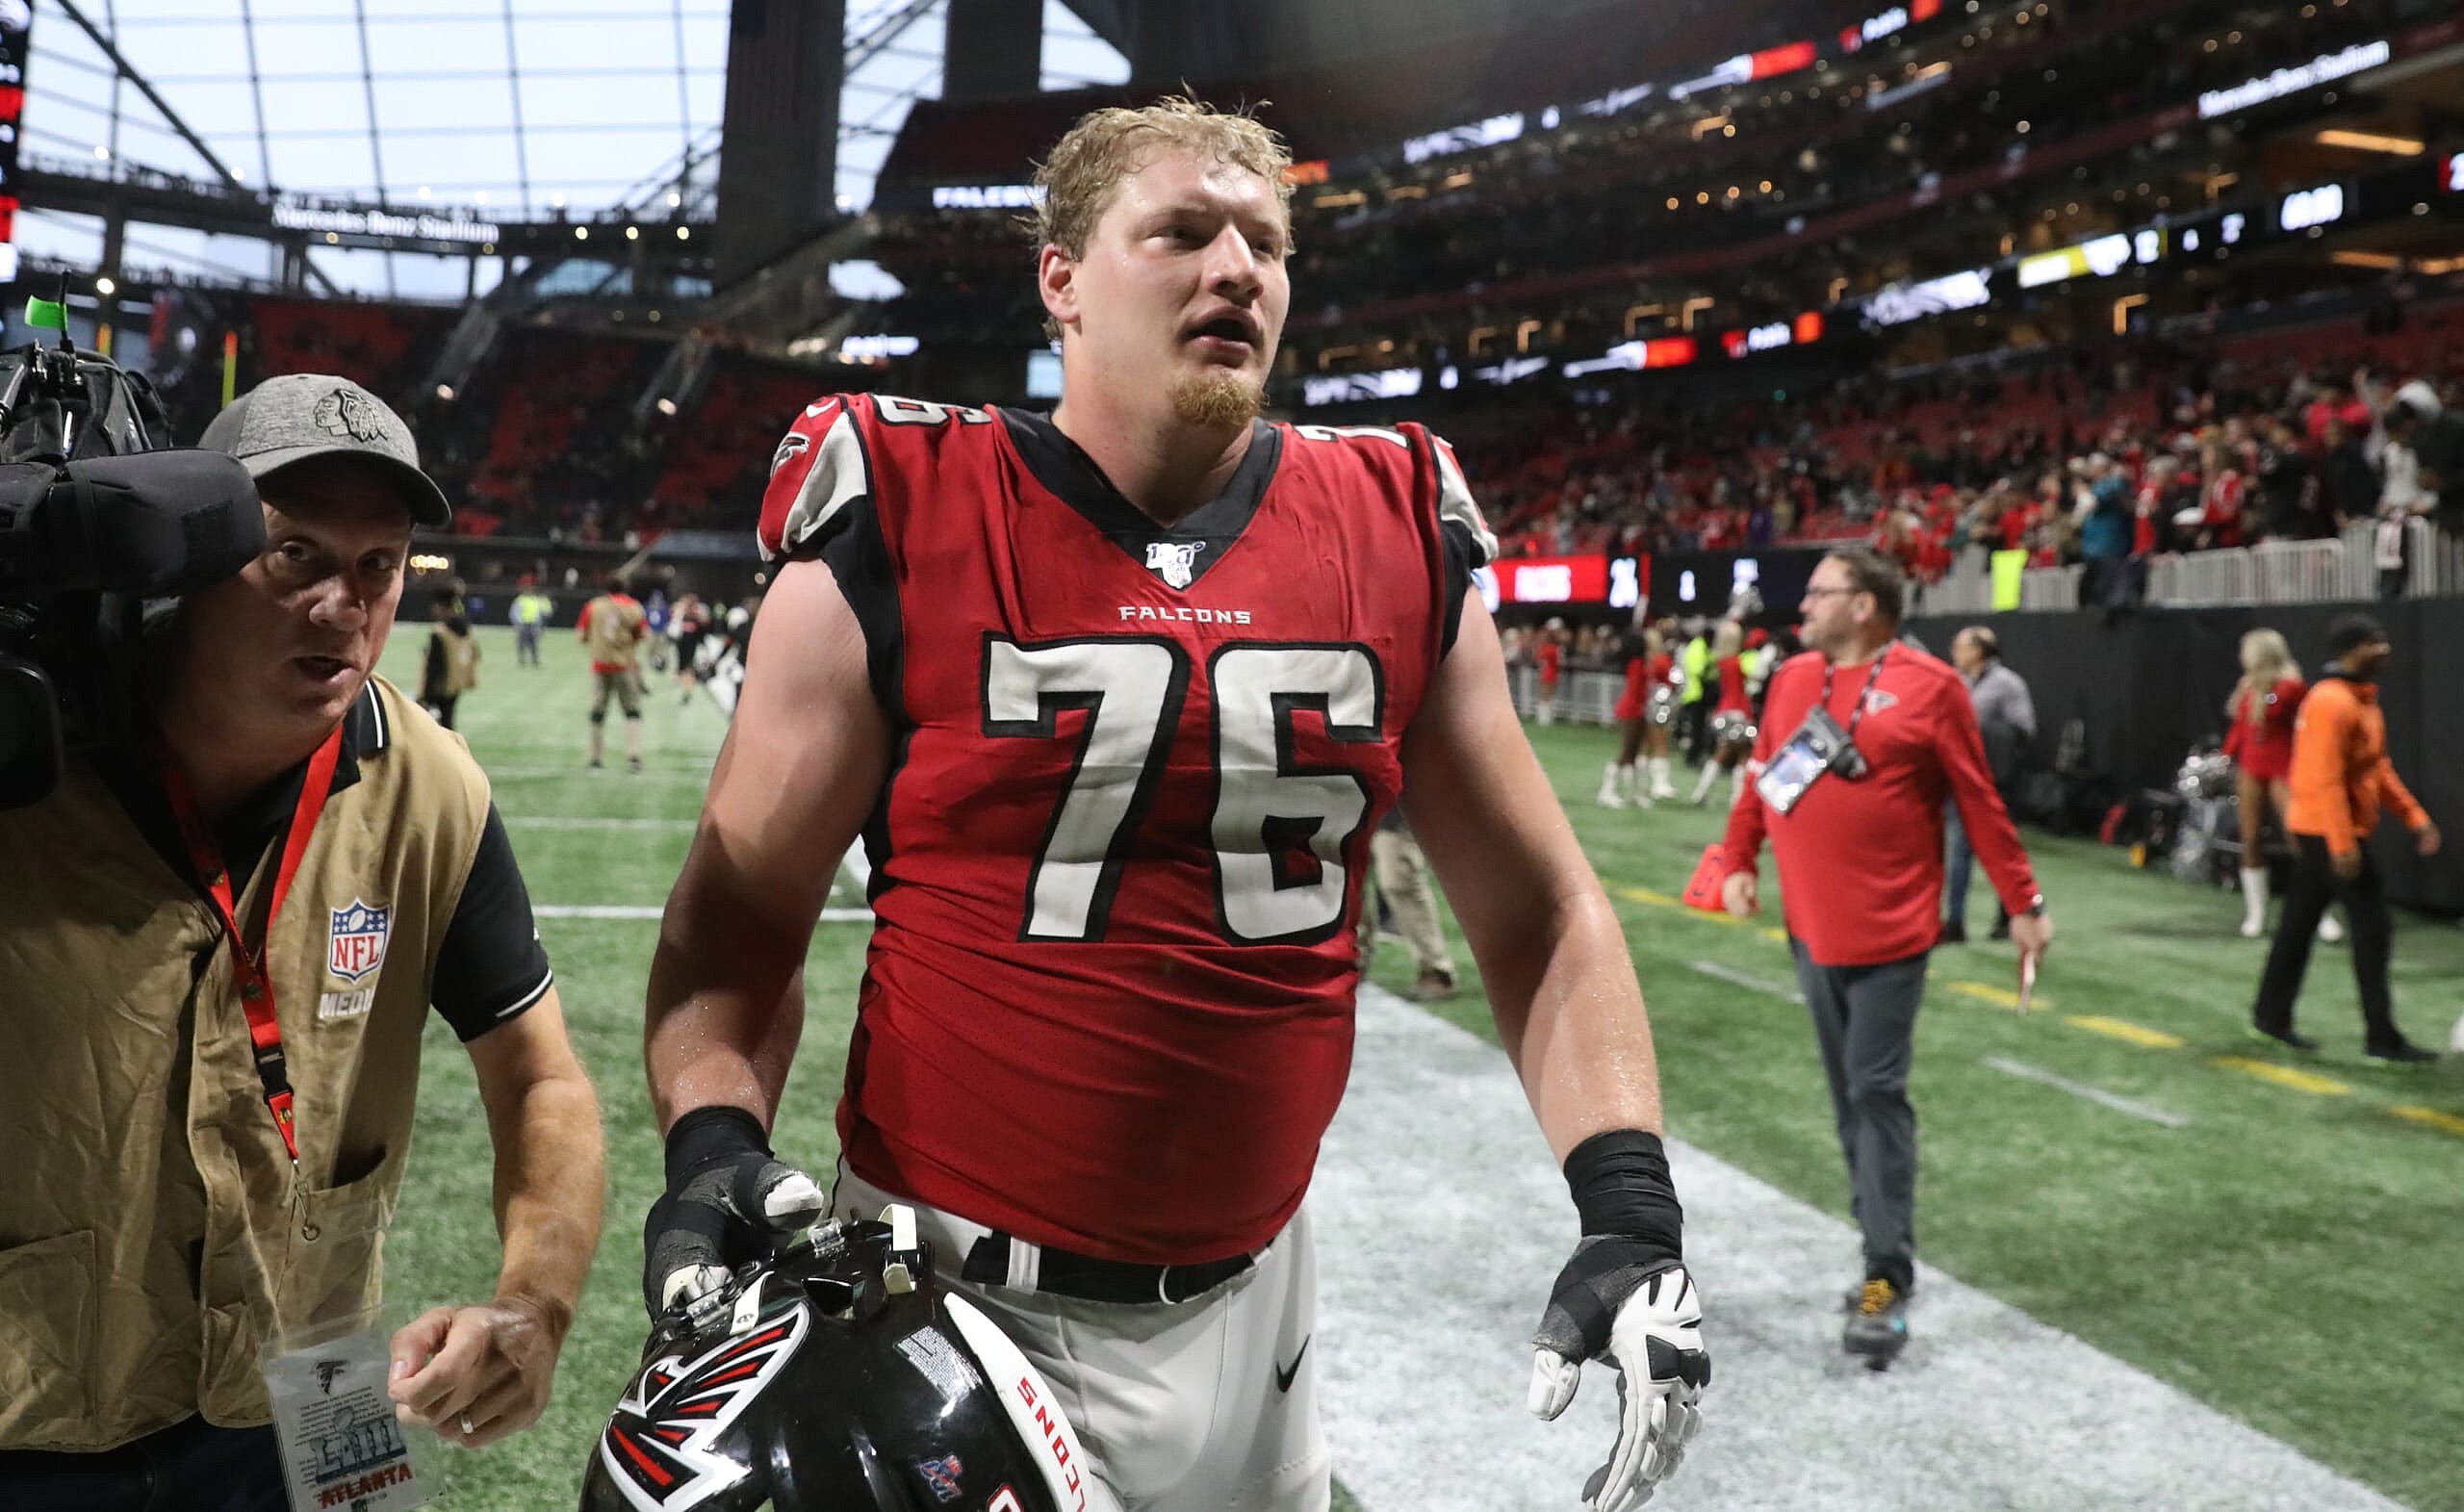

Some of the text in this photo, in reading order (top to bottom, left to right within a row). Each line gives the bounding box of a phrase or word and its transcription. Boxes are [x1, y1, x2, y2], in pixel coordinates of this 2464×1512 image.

[1118, 605, 1251, 625] FALCONS
[985, 634, 1381, 943] 76
[334, 935, 380, 972] NFL
[319, 987, 375, 1019] MEDI
[321, 1462, 413, 1509] ATLANTA
